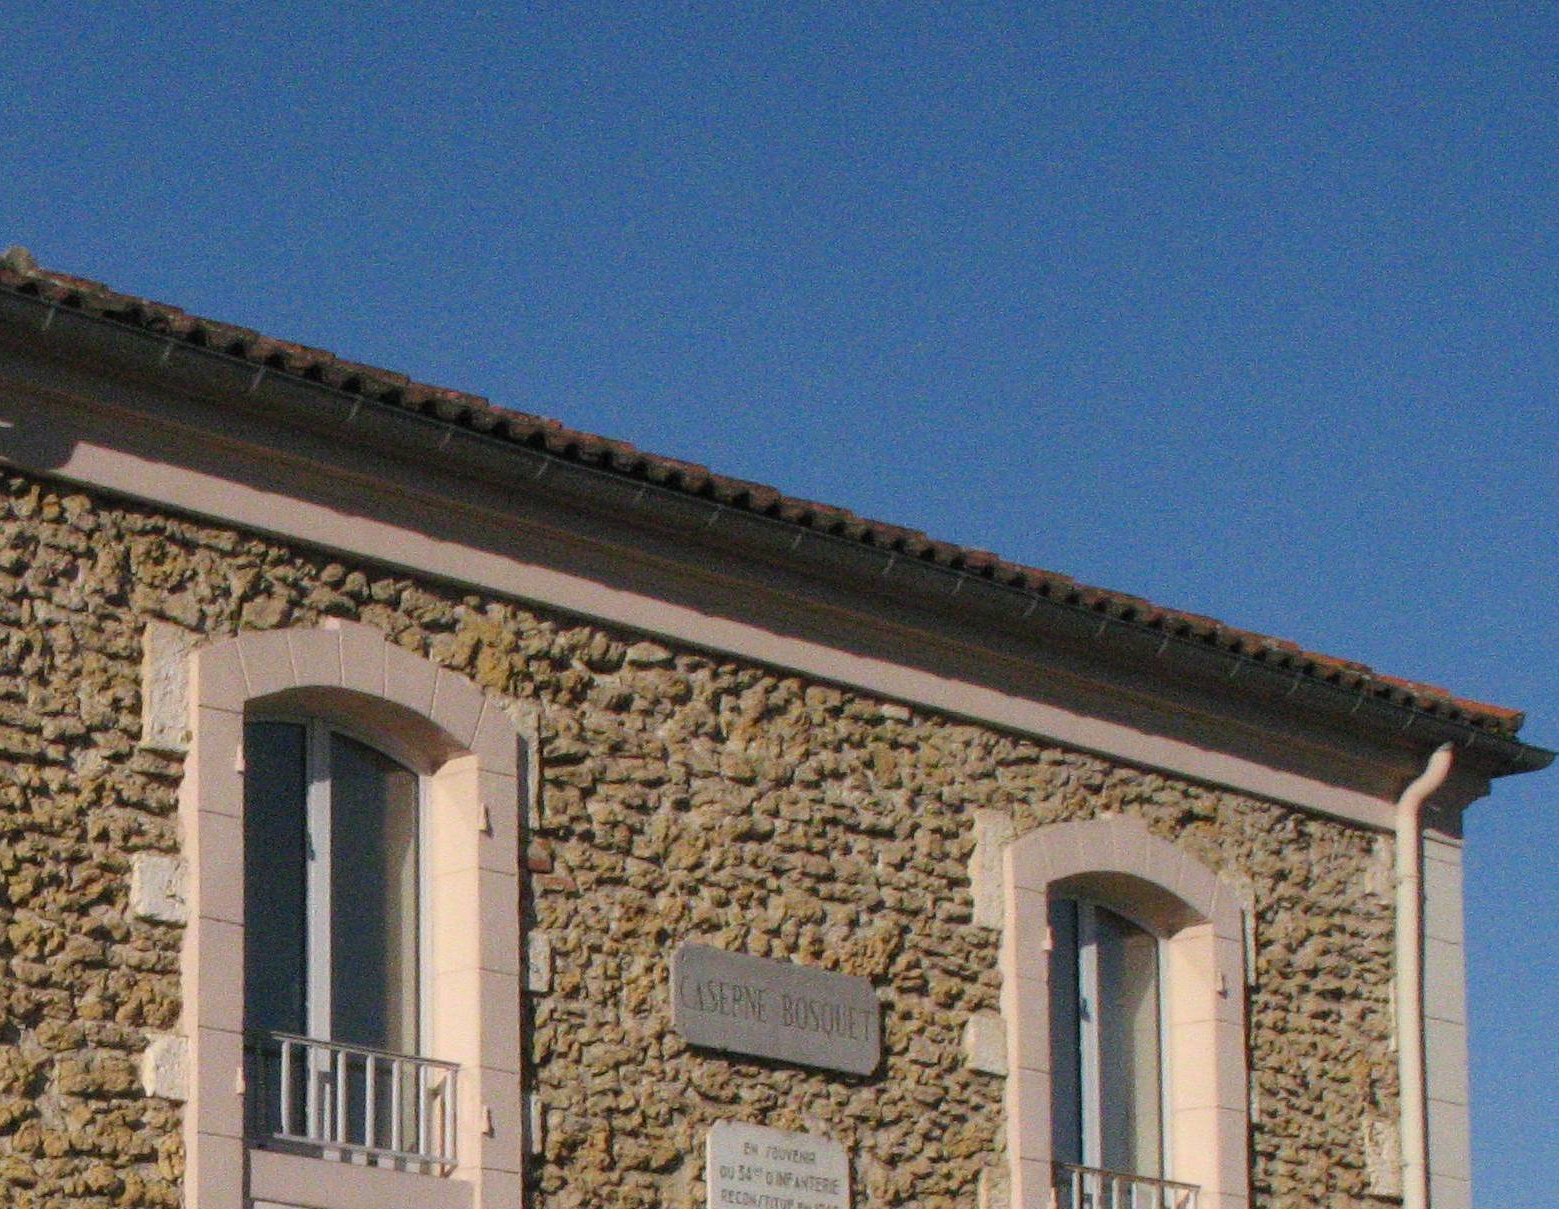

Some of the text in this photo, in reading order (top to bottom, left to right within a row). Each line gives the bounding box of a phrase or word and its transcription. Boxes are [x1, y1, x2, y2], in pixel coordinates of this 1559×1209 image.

[680, 976, 871, 1041] CASERNE BOSQUET
[767, 1145, 816, 1164] SOUVENIR
[720, 1165, 735, 1179] DU
